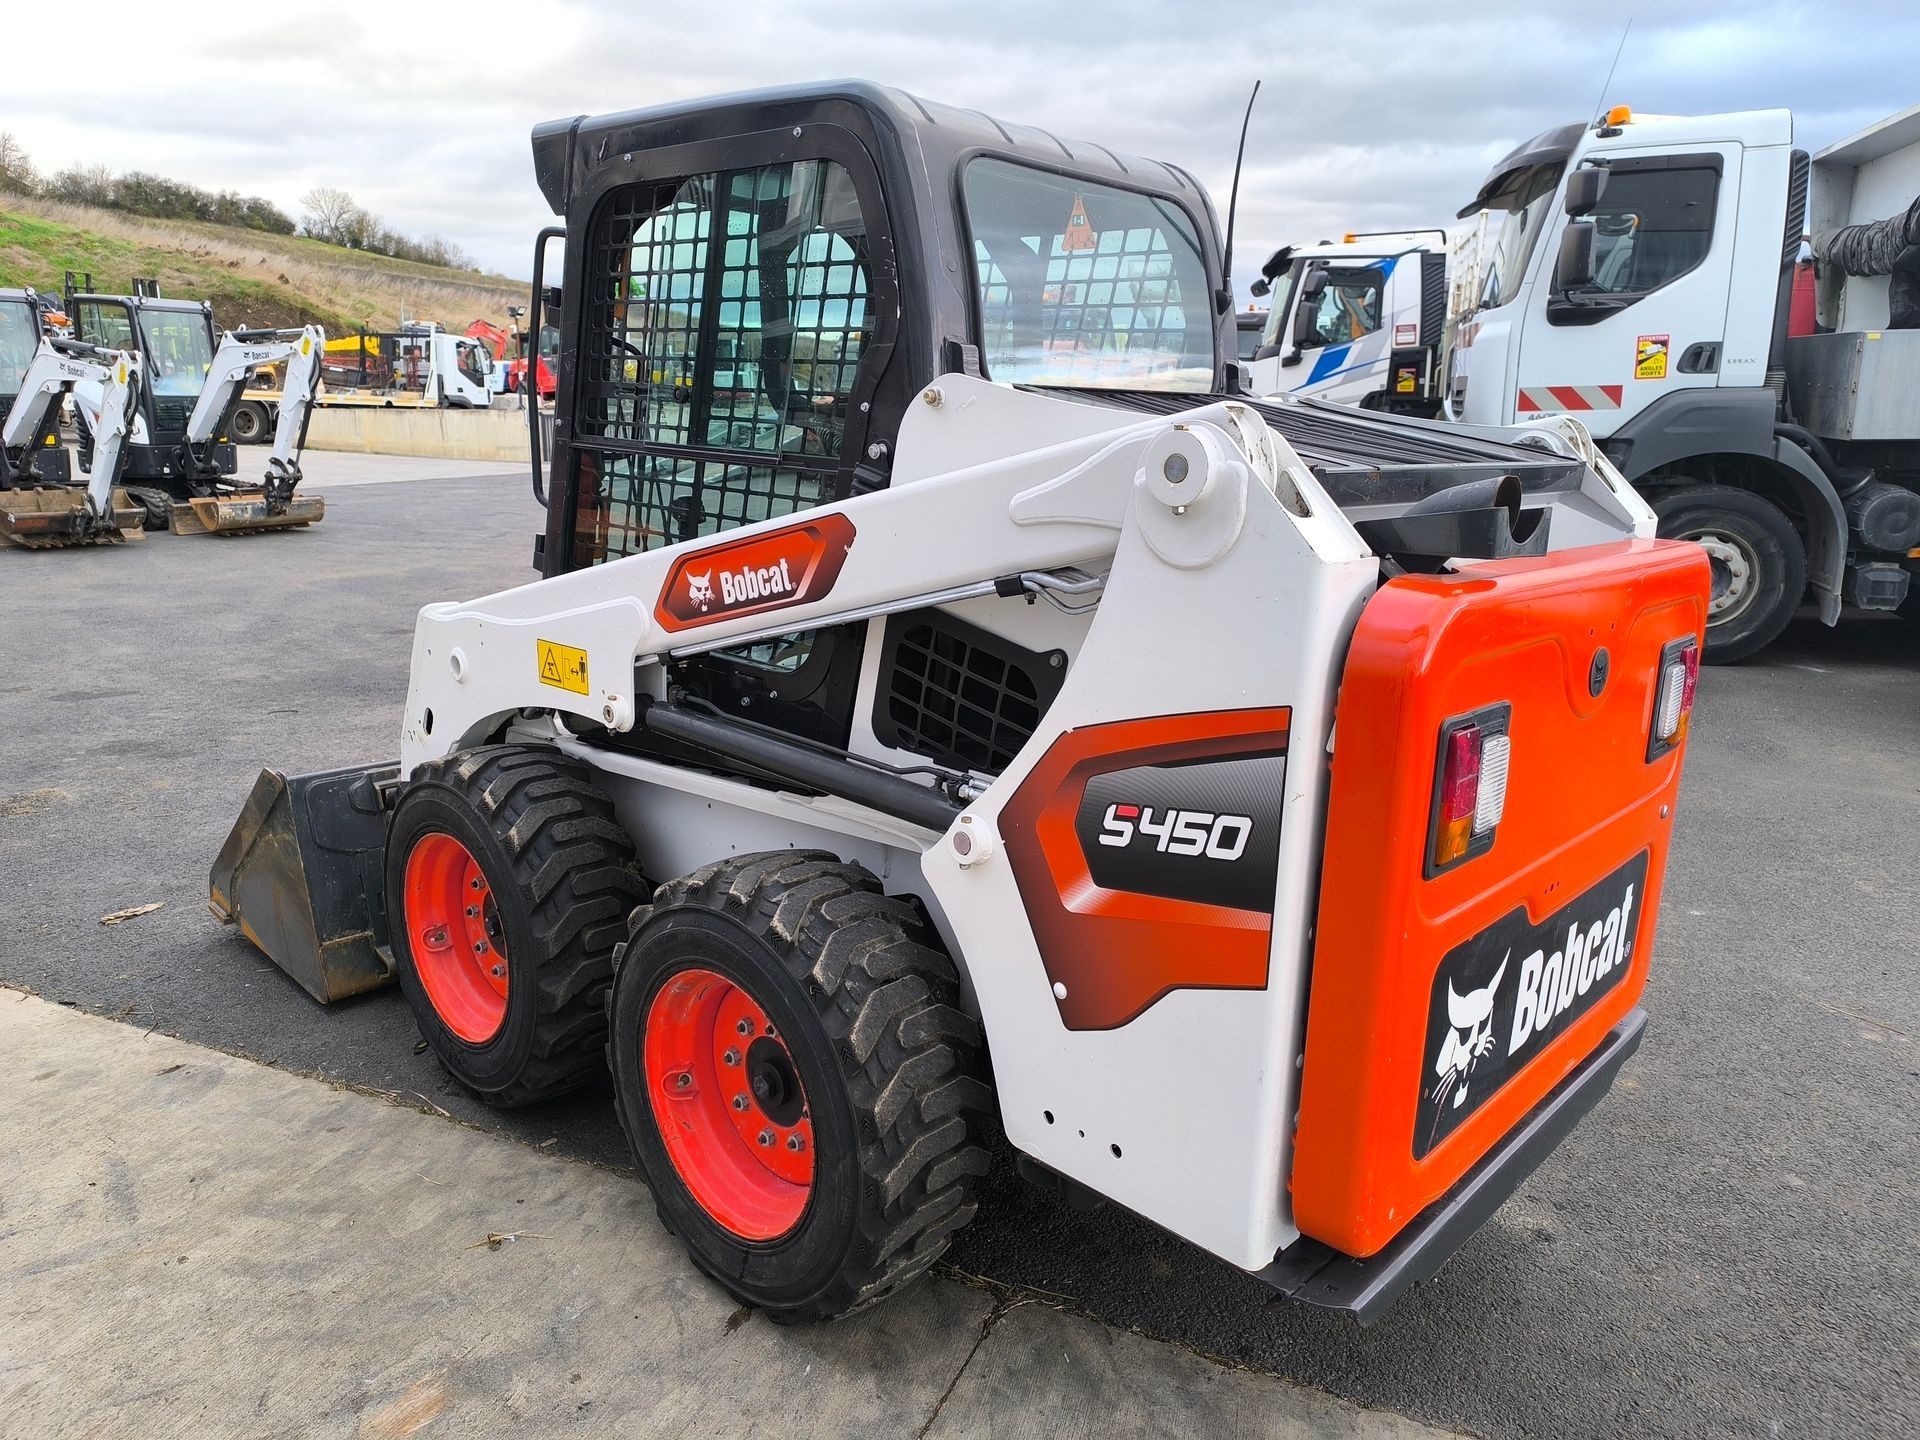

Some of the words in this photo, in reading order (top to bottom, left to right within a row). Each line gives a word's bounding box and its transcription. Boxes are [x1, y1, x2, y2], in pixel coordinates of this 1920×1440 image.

[67, 365, 85, 379] Bobcat
[720, 558, 792, 605] Bobcat
[1099, 804, 1253, 861] S450
[1508, 883, 1634, 1057] Bobcat
